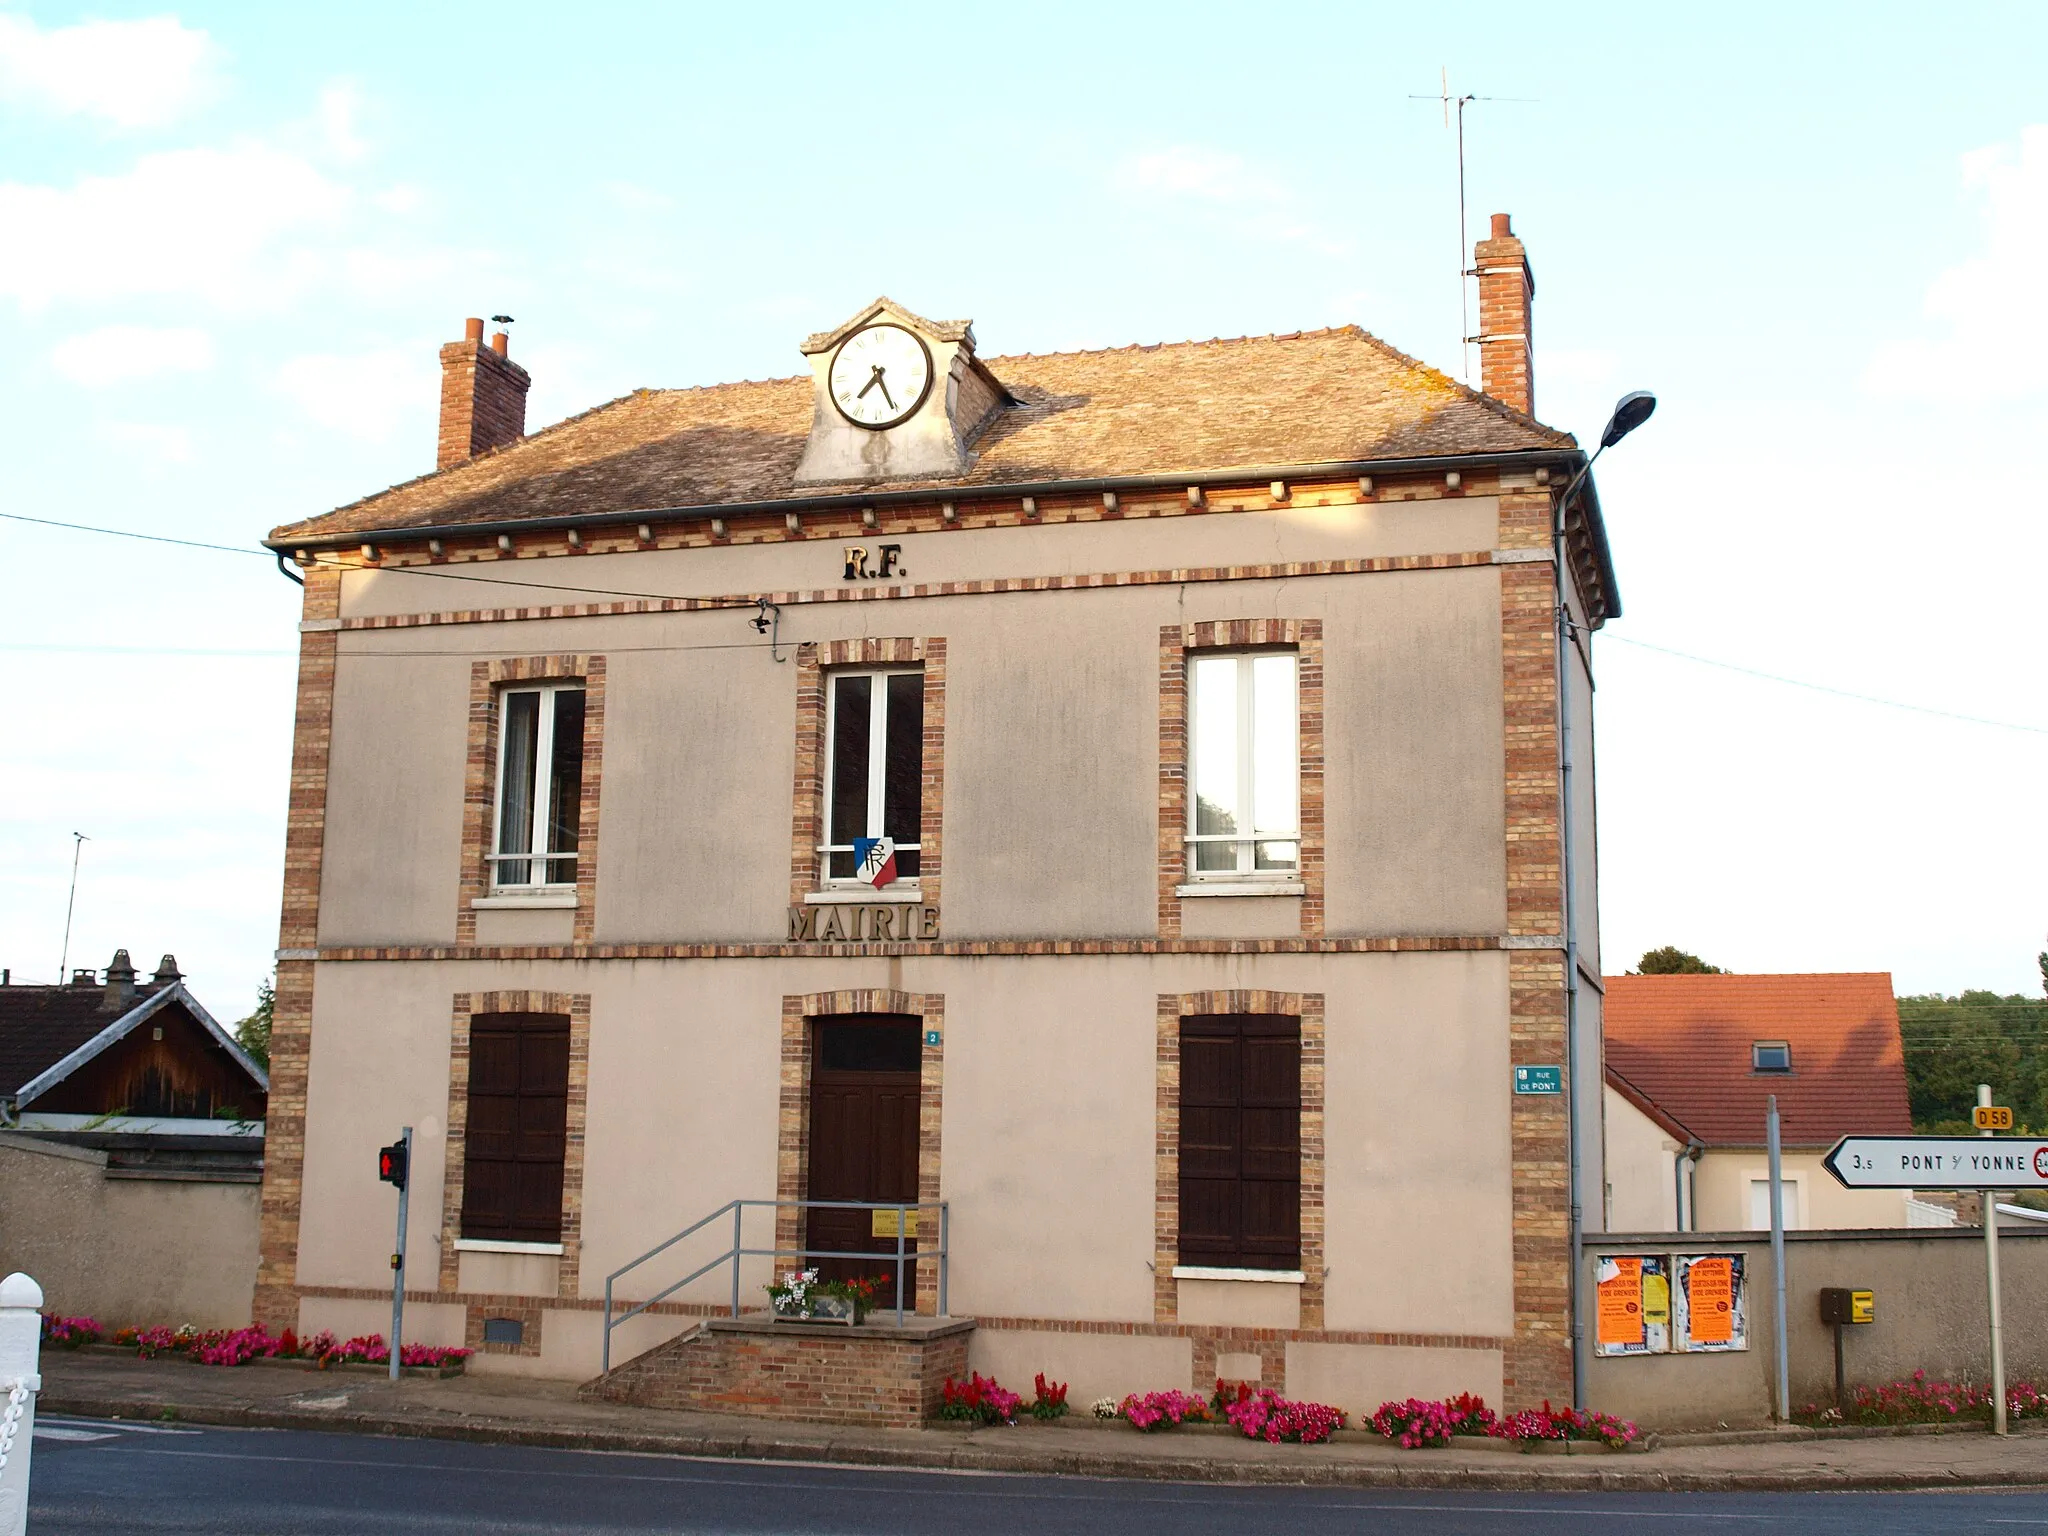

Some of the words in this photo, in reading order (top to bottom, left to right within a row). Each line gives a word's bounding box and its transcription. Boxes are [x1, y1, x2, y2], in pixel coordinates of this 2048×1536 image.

[843, 543, 907, 580] R.F.
[787, 904, 941, 941] MAIRIE
[929, 1034, 936, 1043] 2
[1532, 1082, 1556, 1090] PONT
[1979, 1111, 1987, 1125] D
[1991, 1111, 2009, 1125] 58
[1852, 1155, 1873, 1170] 3.5
[1901, 1155, 1943, 1170] PONT
[1971, 1156, 2026, 1170] YONNE
